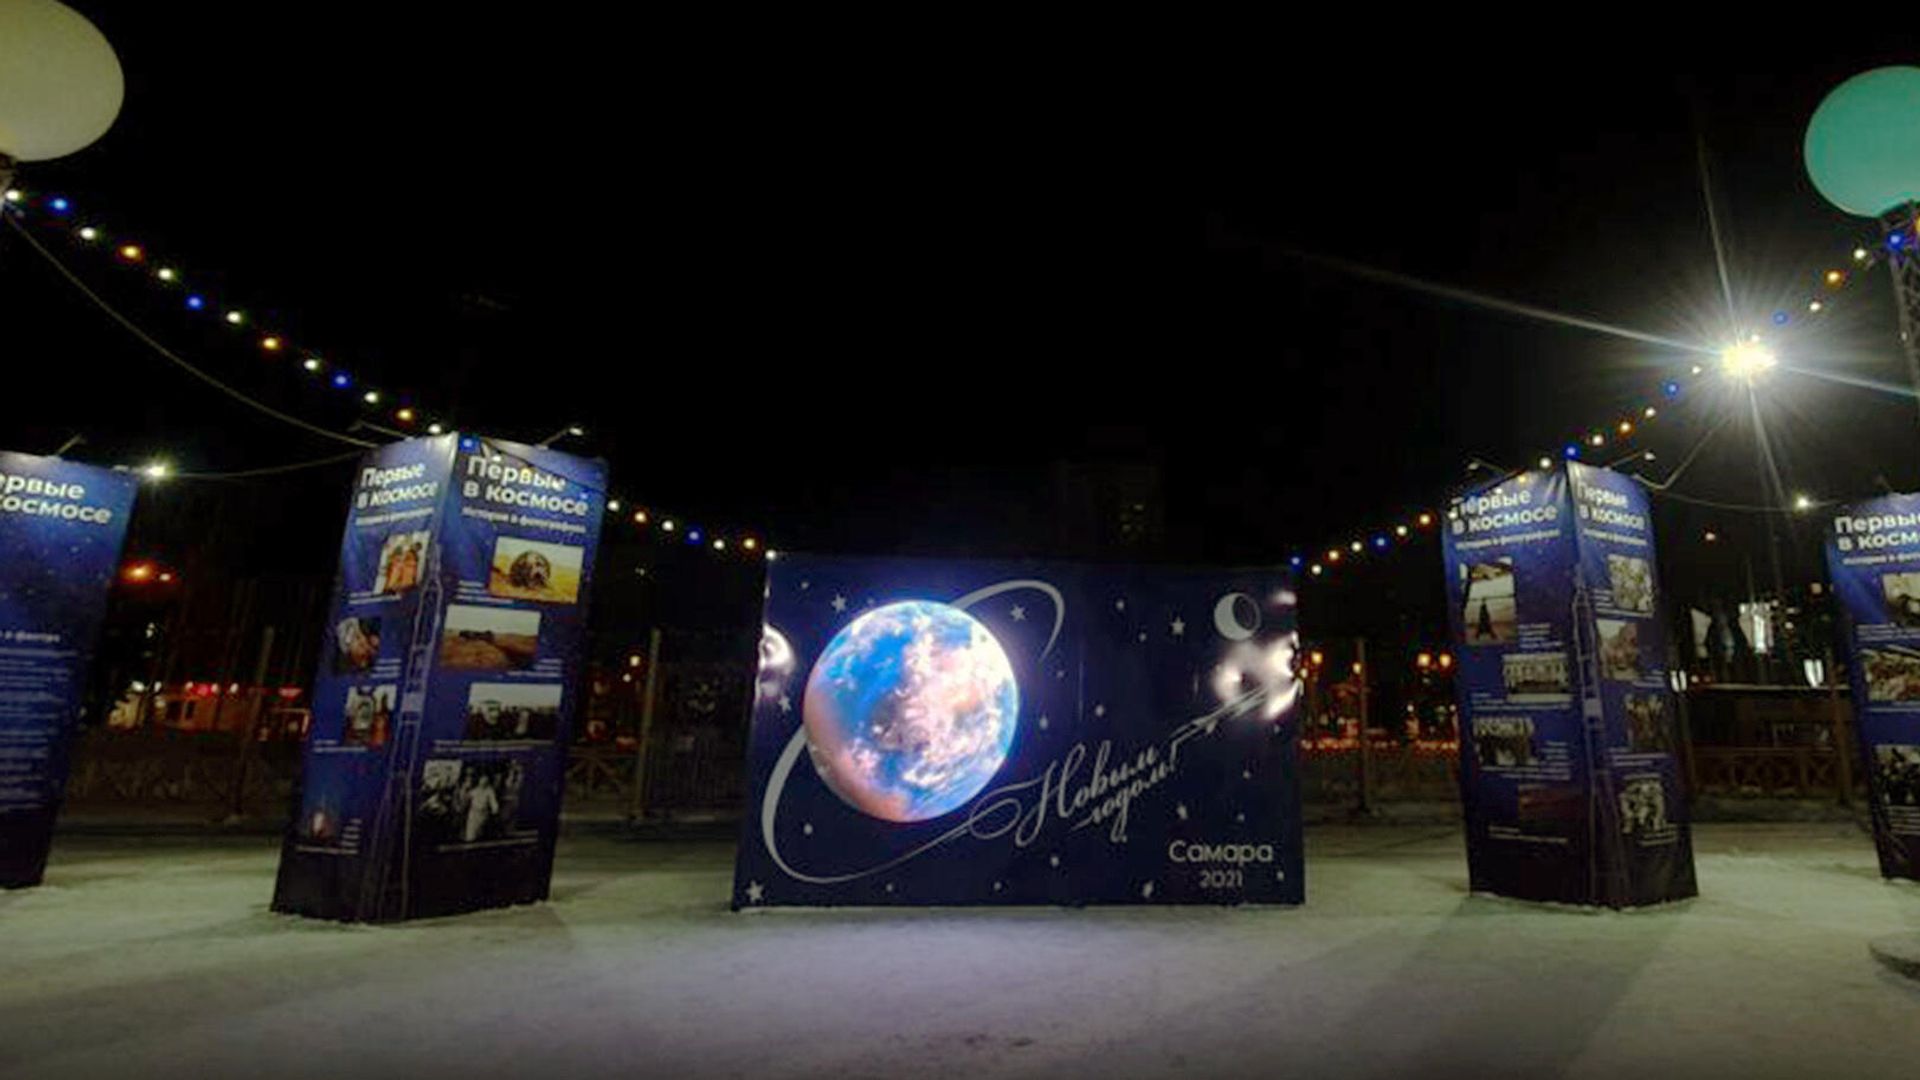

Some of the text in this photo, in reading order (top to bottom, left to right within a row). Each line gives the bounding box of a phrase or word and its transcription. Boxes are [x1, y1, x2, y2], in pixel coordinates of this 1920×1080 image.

[361, 463, 426, 488] Первые
[468, 455, 566, 492] Первые
[0, 494, 113, 525] осмосе
[463, 480, 589, 516] в космосе
[1468, 504, 1557, 533] космосе
[1837, 536, 1852, 551] в
[1168, 839, 1273, 867] Самара
[1200, 870, 1243, 888] 2021
